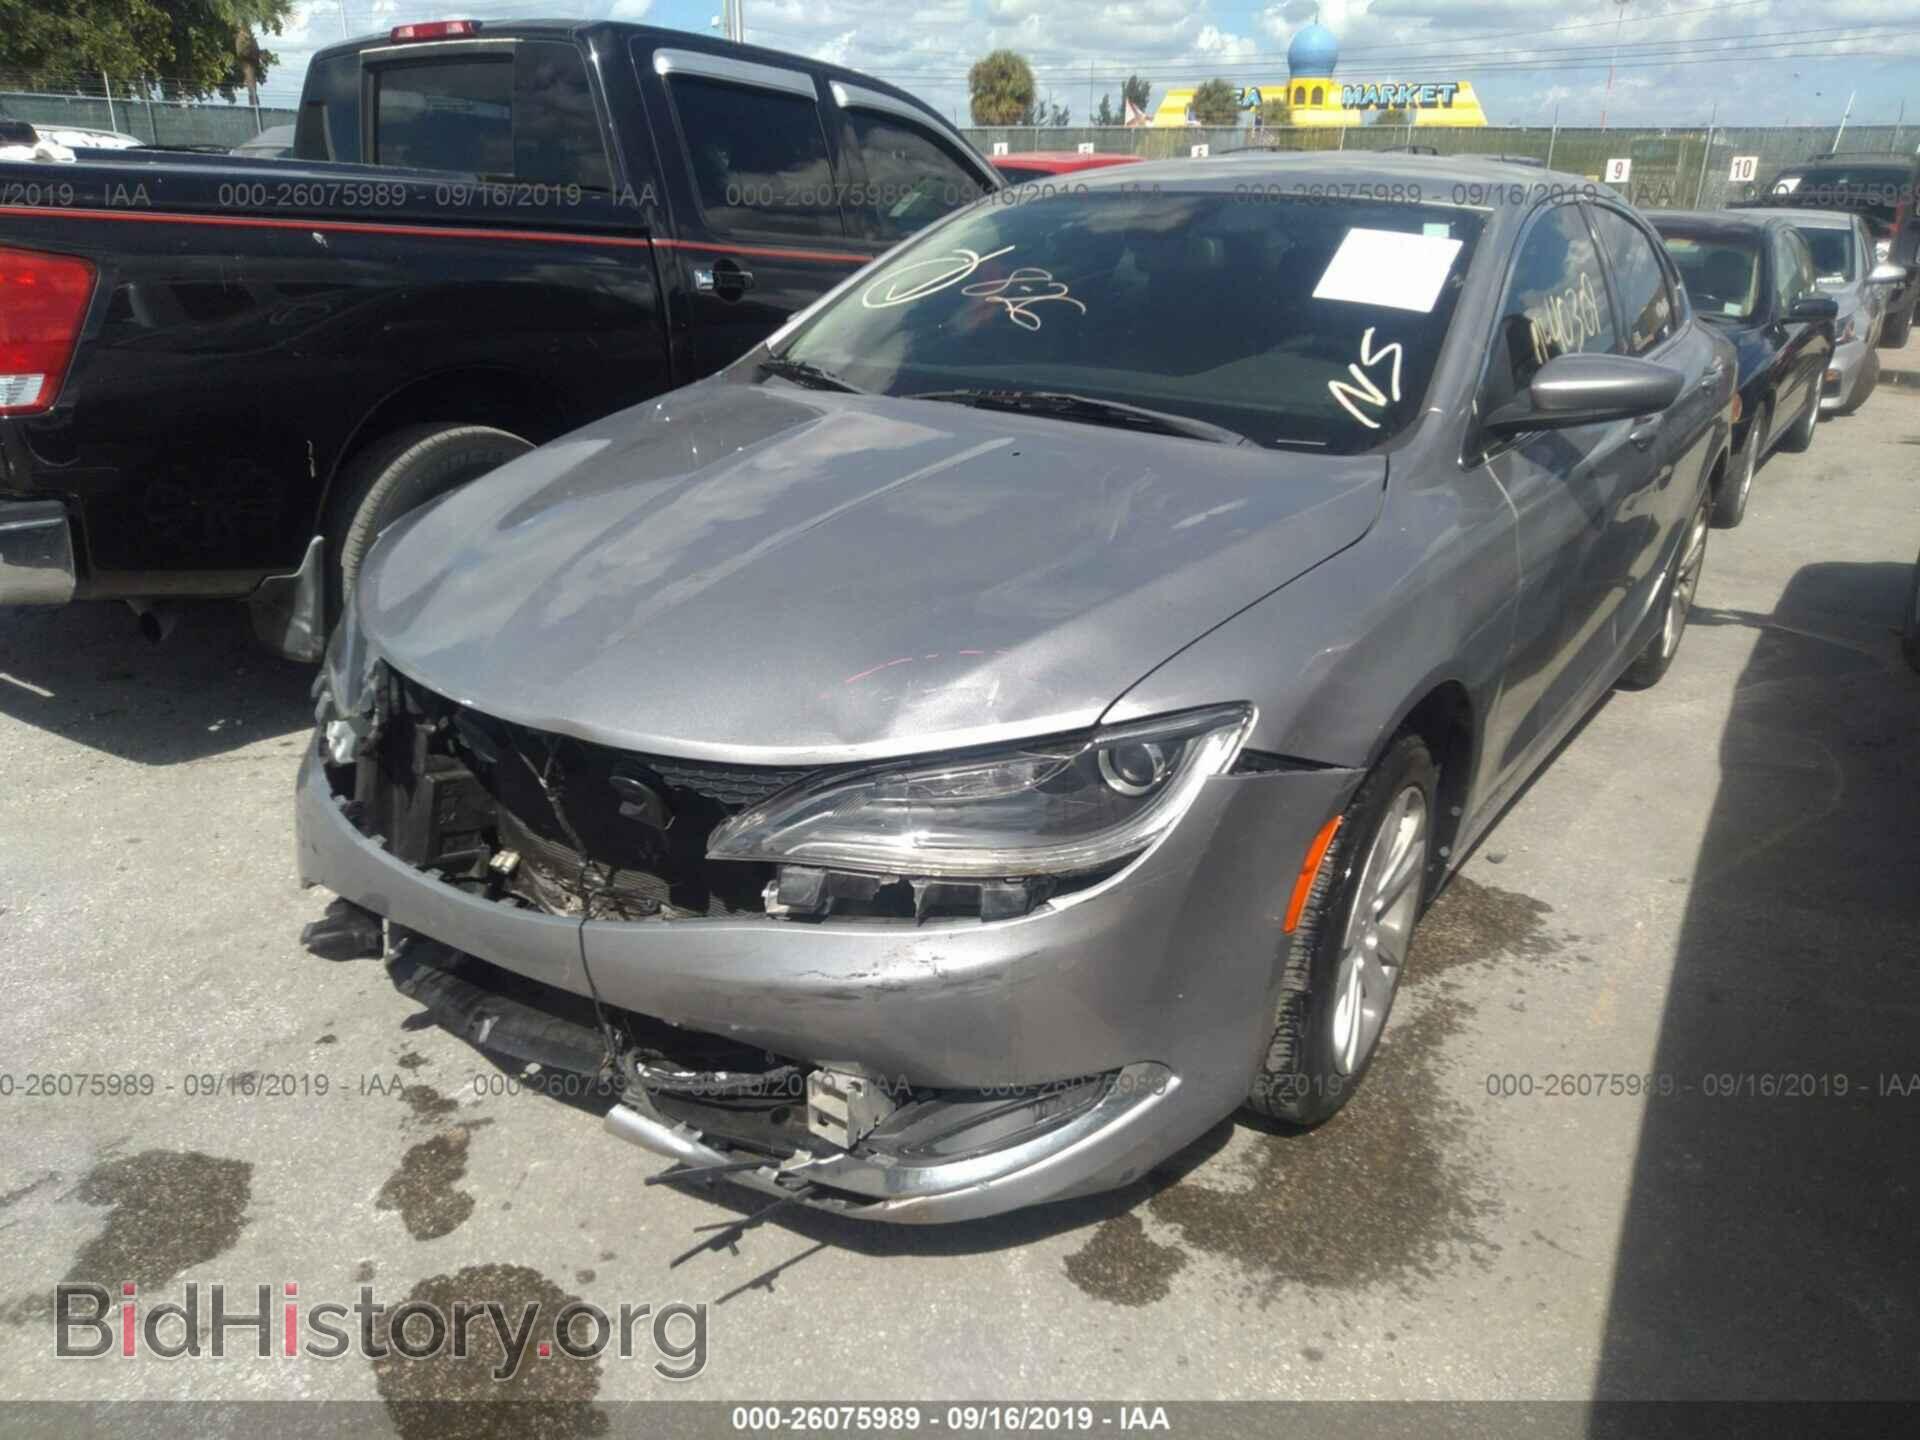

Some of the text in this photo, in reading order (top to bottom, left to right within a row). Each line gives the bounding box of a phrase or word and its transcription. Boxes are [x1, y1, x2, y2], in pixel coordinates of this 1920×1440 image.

[1341, 82, 1460, 110] MARKET
[1614, 161, 1624, 180] 9
[1734, 159, 1753, 179] 10
